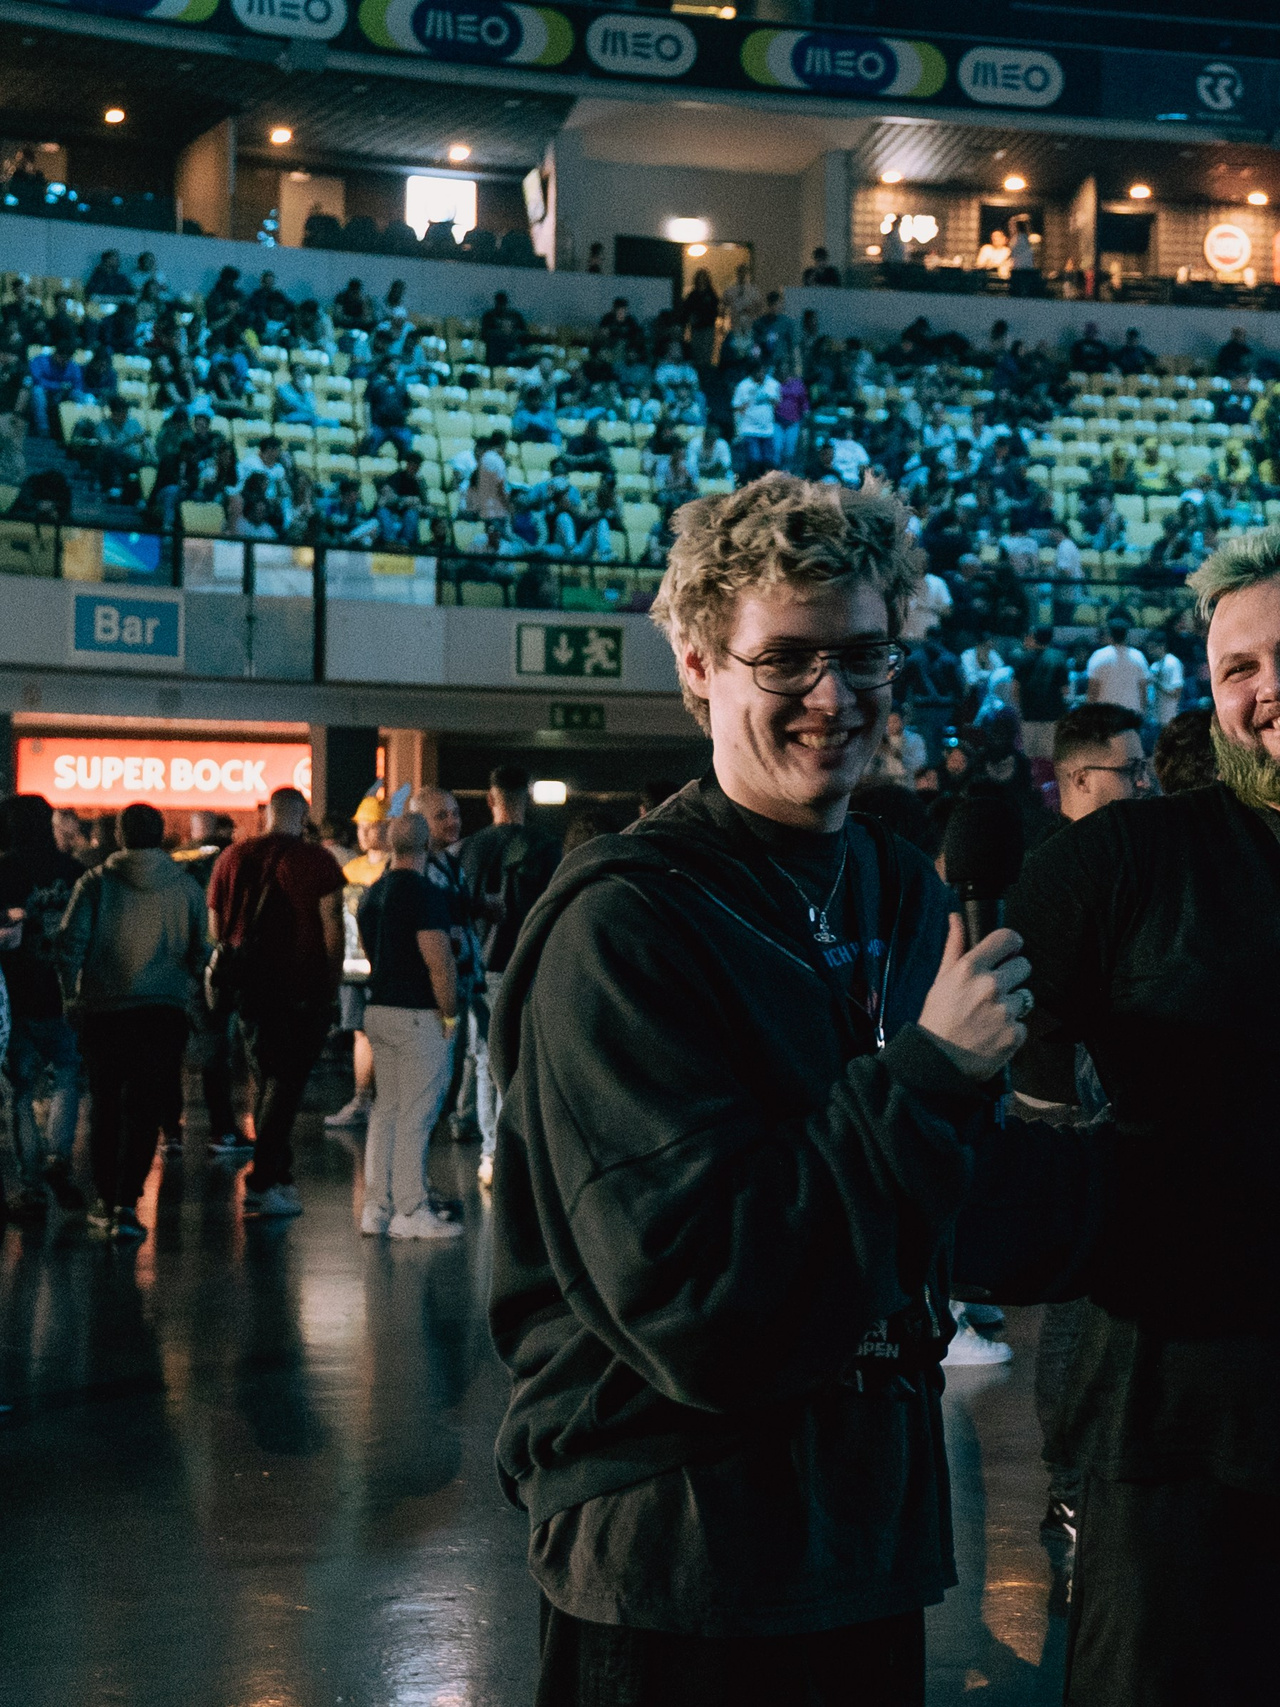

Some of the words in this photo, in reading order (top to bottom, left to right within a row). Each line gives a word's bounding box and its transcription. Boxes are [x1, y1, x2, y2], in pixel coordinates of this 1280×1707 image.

[425, 8, 510, 47] MEO
[601, 28, 683, 62] MEO
[804, 46, 885, 81] MEO
[972, 61, 1050, 93] MEO
[94, 605, 161, 645] Bar
[54, 755, 166, 791] SUPER
[170, 757, 268, 792] BOCK
